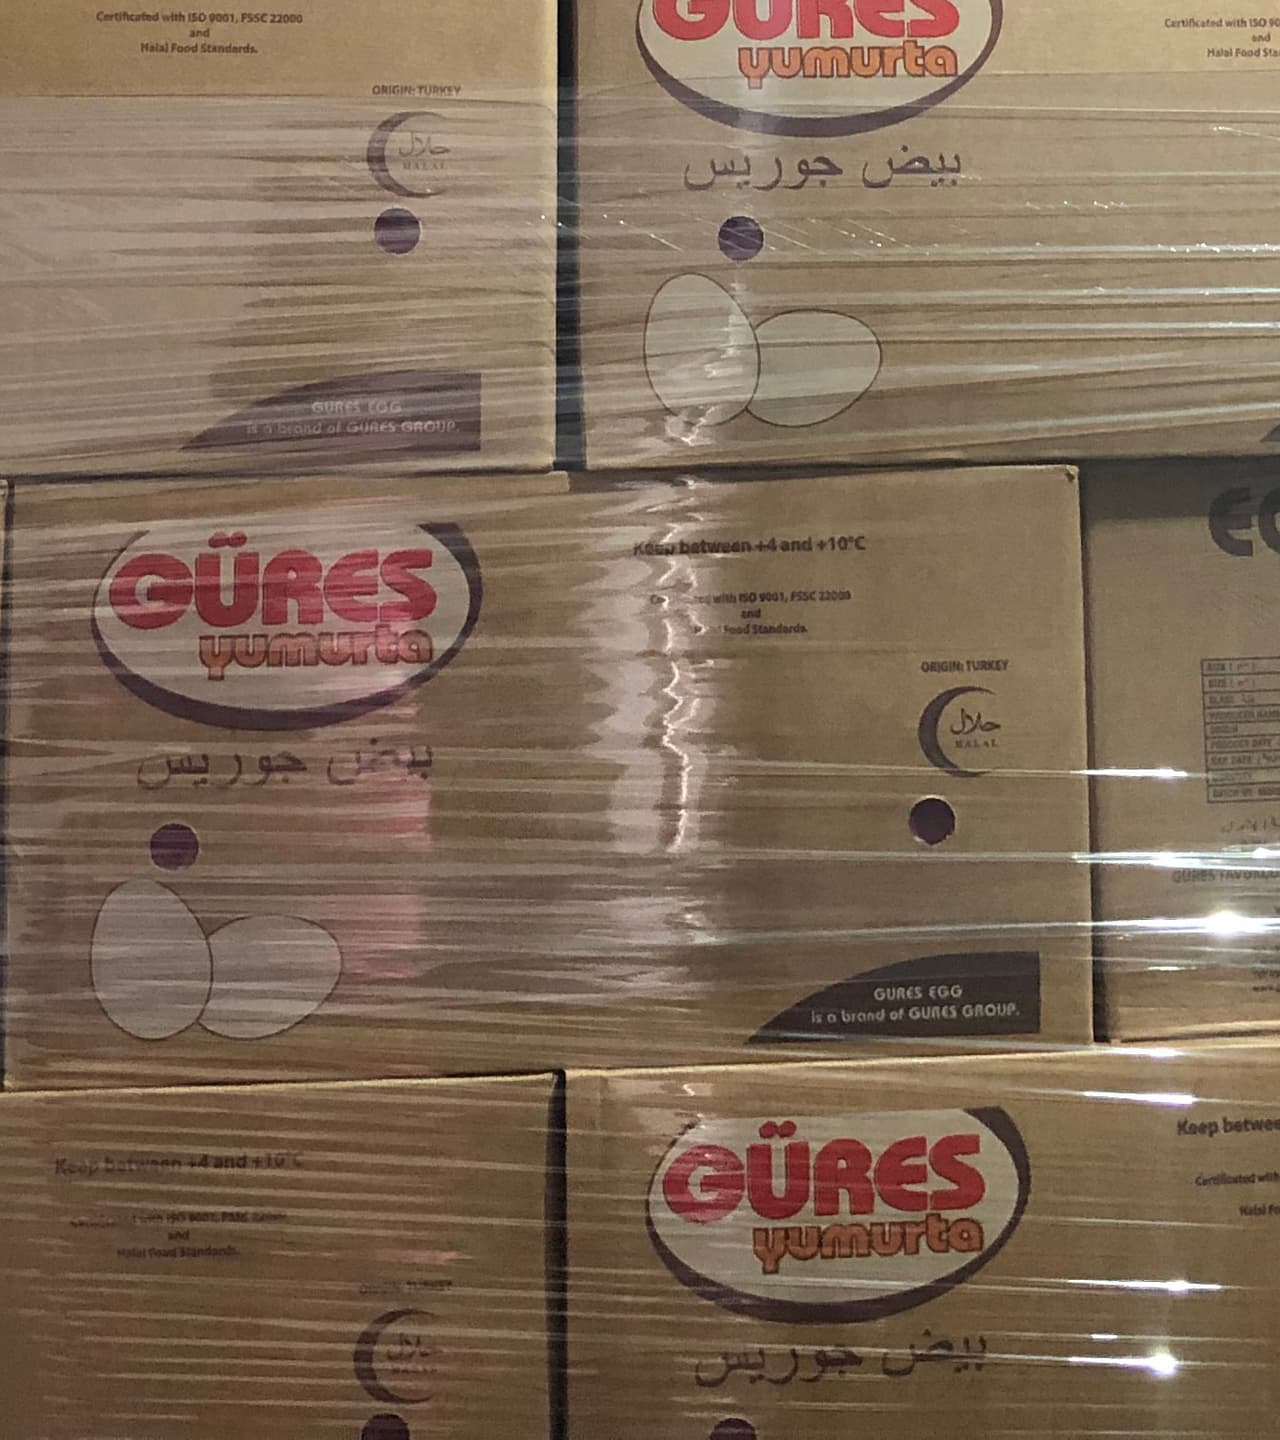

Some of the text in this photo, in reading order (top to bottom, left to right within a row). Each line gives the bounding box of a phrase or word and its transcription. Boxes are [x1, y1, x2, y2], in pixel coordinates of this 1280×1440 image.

[96, 12, 159, 23] Certificated
[162, 13, 185, 23] with
[188, 13, 205, 23] ISO
[242, 14, 267, 24] FSSC
[270, 14, 303, 24] 22000
[1164, 18, 1222, 28] Certificated
[1226, 18, 1247, 28] with
[1250, 18, 1266, 28] ISO
[190, 28, 210, 38] and
[1252, 33, 1270, 42] and
[140, 44, 258, 54] Halal Food Standards.
[1208, 48, 1232, 58] Halal
[1235, 48, 1260, 58] Food
[738, 41, 958, 89] yumurta
[372, 85, 462, 96] ORIGIN: TURKEY
[684, 146, 962, 191] بيض جوريس
[680, 540, 751, 554] between
[756, 538, 776, 552] +4
[780, 537, 812, 552] and
[816, 536, 866, 551] +10°C
[108, 532, 437, 629] GÜRES
[738, 593, 756, 603] ISO
[790, 591, 816, 602] FSSC
[741, 610, 760, 618] and
[752, 624, 808, 634] Standards.
[198, 624, 433, 680] yumurta
[966, 660, 1008, 671] TURKEY
[136, 738, 433, 790] بيض جوريس
[874, 985, 962, 1000] GURES EGG
[812, 1003, 1020, 1023] is a brand of GURES GROUP.
[1177, 1120, 1219, 1137] Keep
[663, 1120, 984, 1223] GÜRES
[753, 1213, 983, 1274] yumurta
[882, 1330, 988, 1376] بيض
